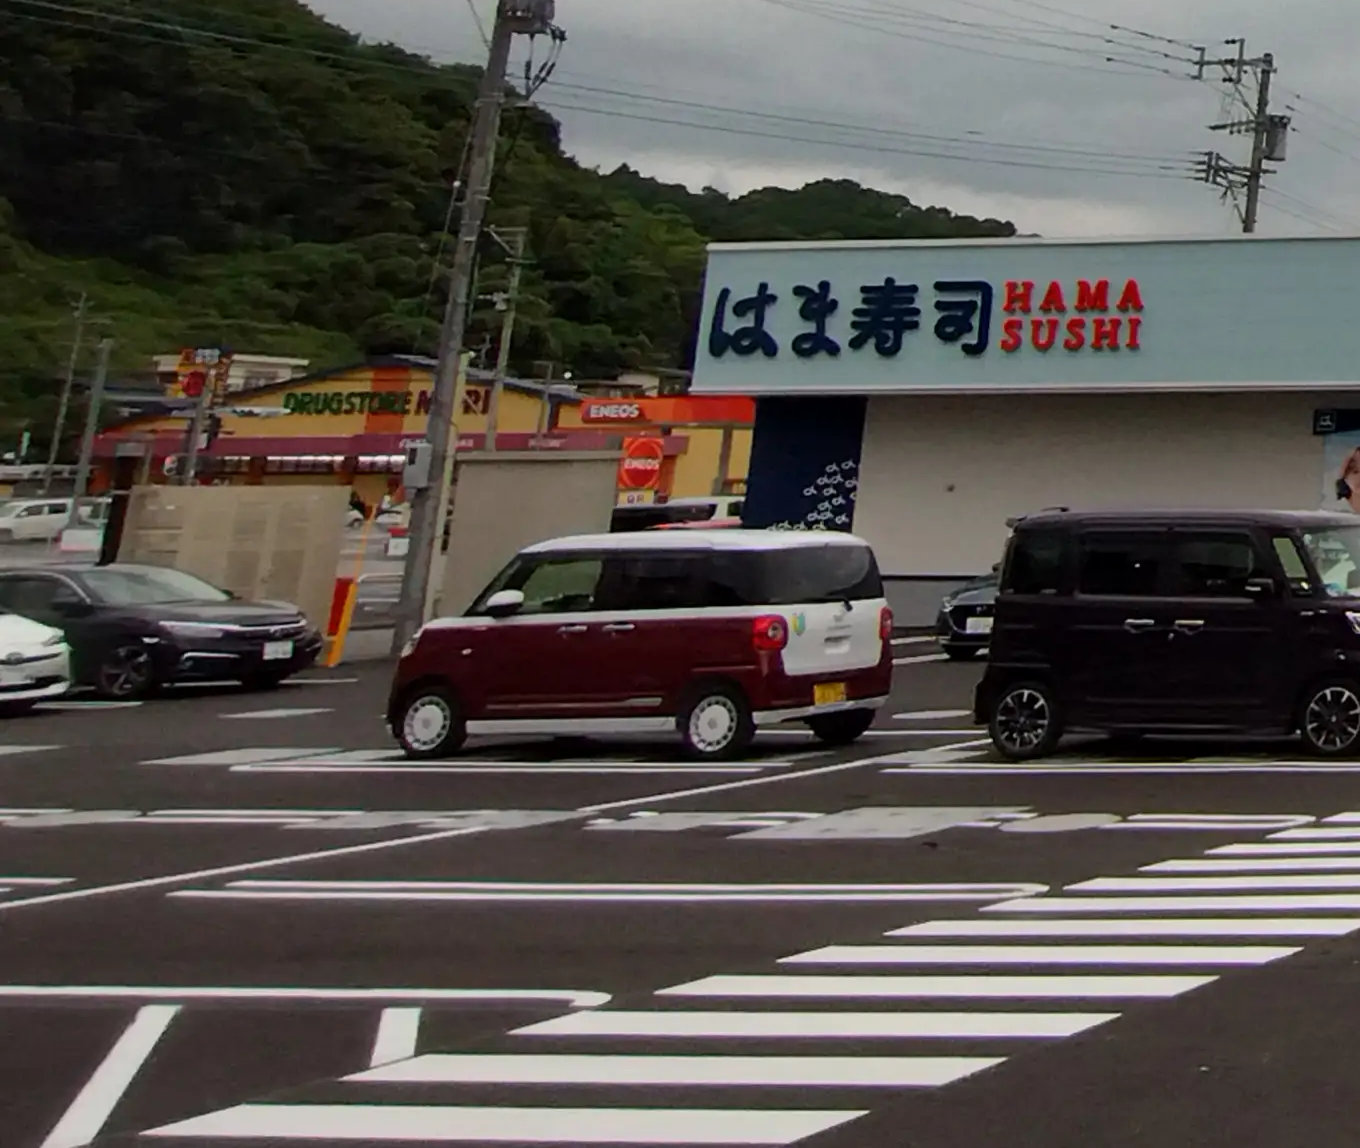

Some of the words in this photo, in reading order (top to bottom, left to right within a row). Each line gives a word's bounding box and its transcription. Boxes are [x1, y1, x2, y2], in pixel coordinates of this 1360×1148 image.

[1002, 278, 1146, 313] HAMA
[708, 276, 993, 357] はま寿司
[1000, 316, 1142, 353] SUSHI
[284, 390, 412, 415] DRUGSTORE
[416, 389, 491, 415] MRI
[589, 404, 639, 418] ENEOS
[624, 458, 660, 469] ENEOS
